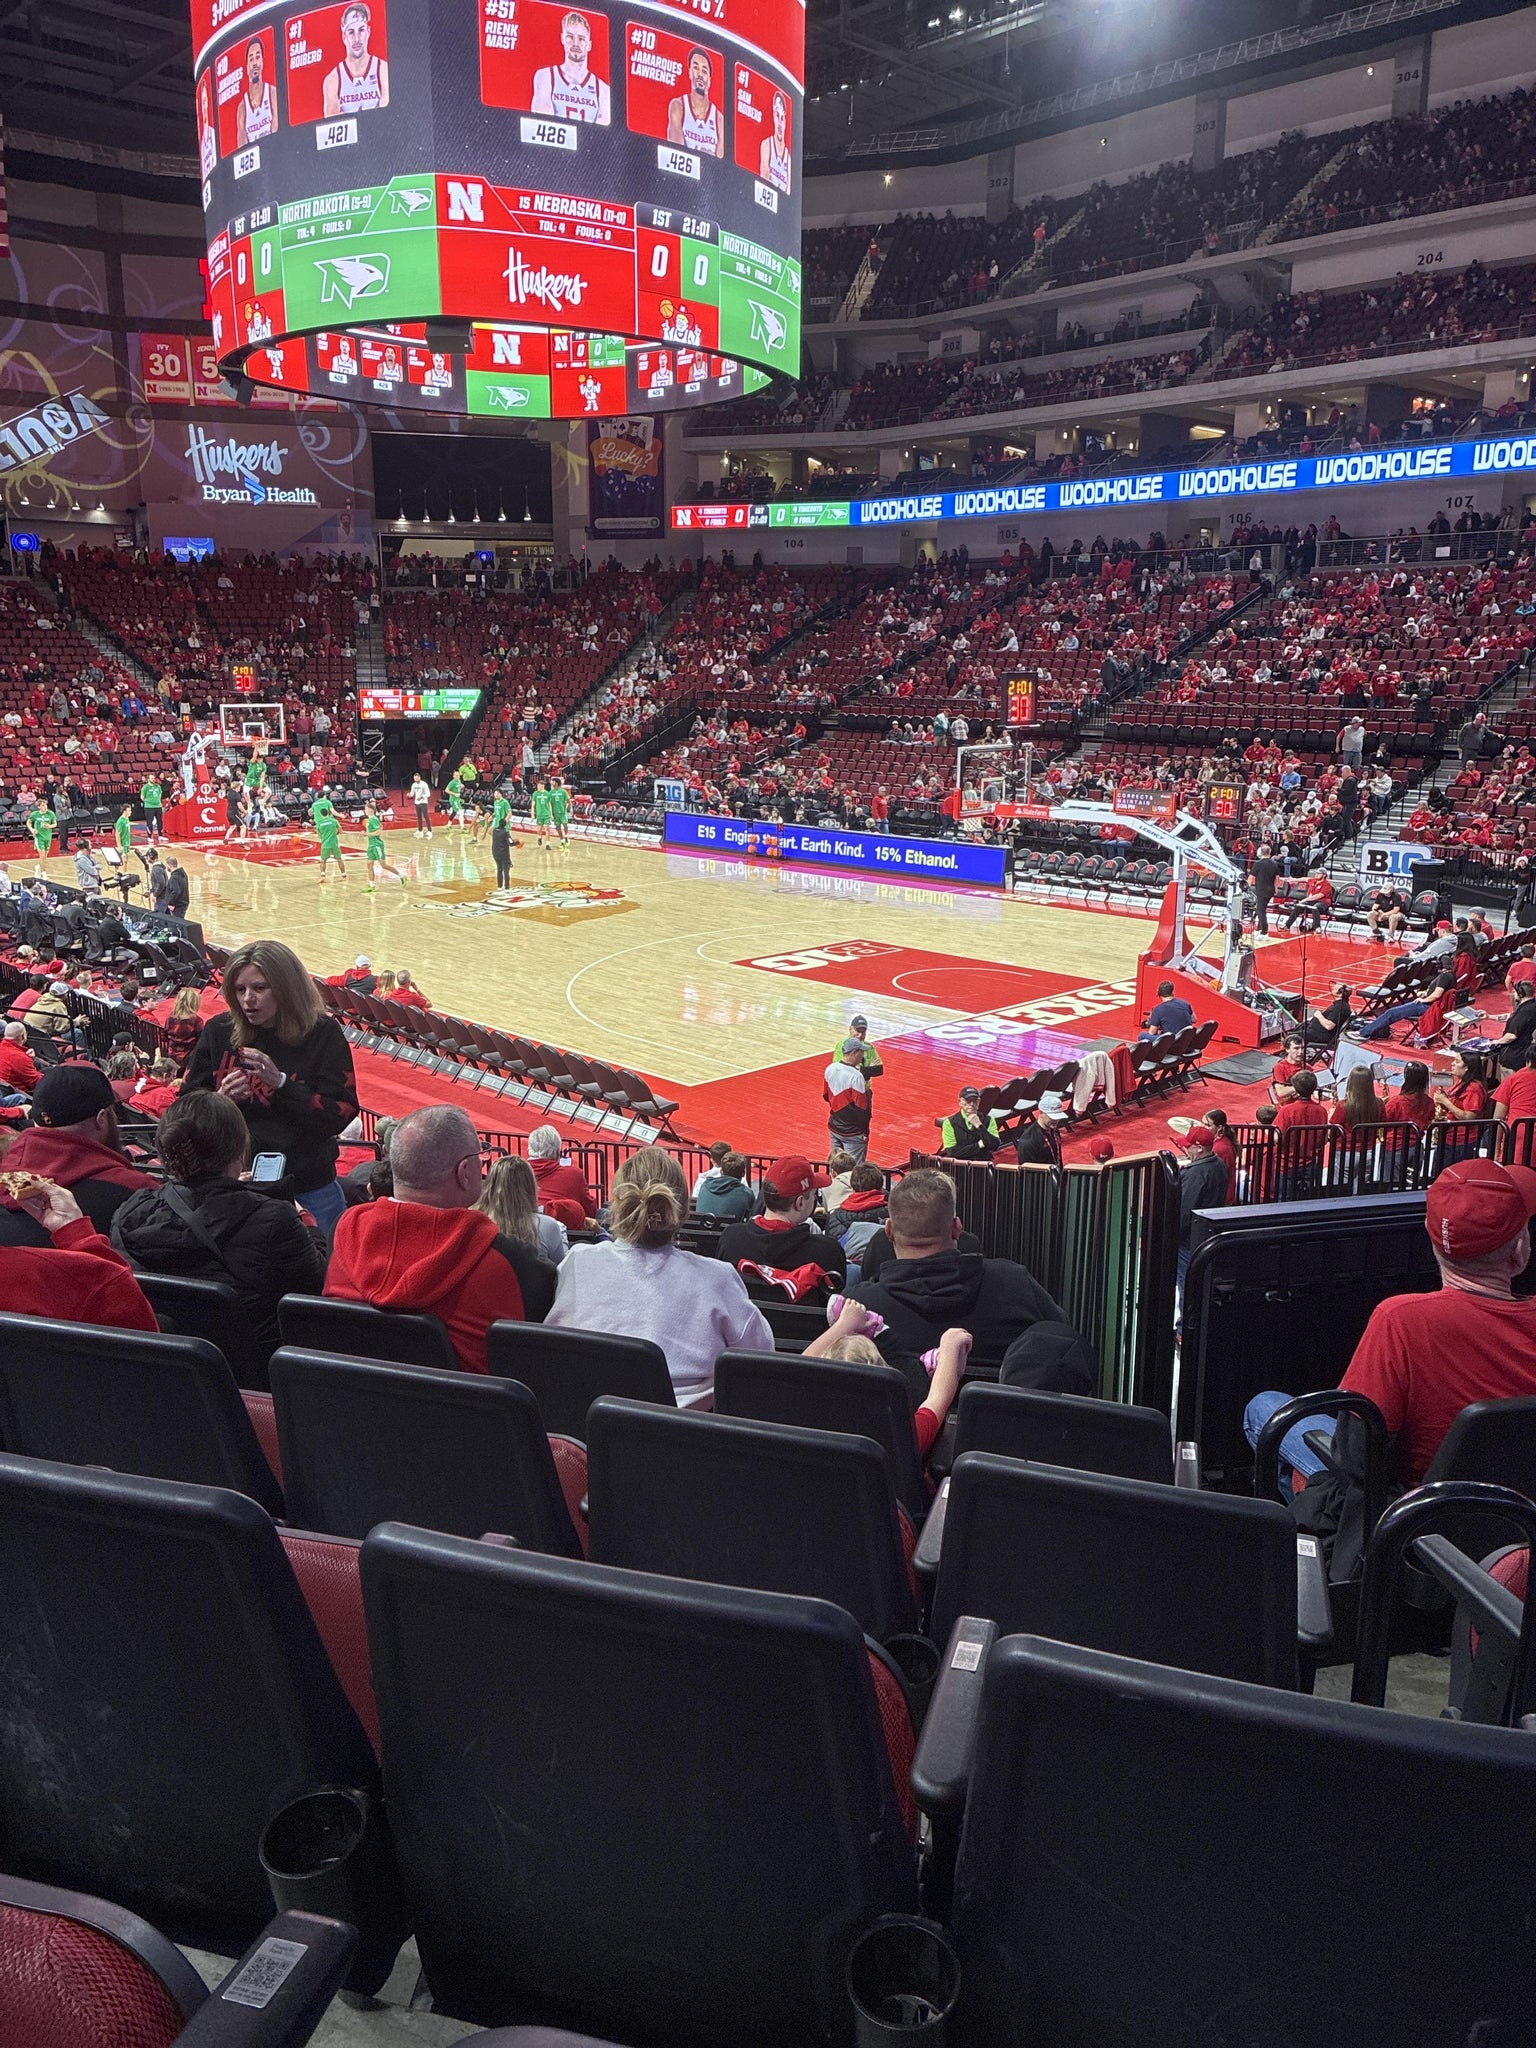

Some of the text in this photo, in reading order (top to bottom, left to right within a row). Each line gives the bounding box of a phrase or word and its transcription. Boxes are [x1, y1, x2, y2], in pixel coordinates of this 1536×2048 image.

[212, 0, 250, 27] 3-POI
[289, 20, 302, 39] #1
[485, 21, 518, 36] RIENK
[290, 40, 306, 57] SAM
[485, 34, 518, 50] MAST
[631, 29, 656, 50] #10
[630, 50, 682, 76] JAMARQUES
[630, 62, 676, 86] LAWRENCE
[738, 70, 749, 88] #1
[1396, 70, 1420, 84] 304
[553, 94, 596, 108] NEBRASKA
[324, 125, 348, 146] .421
[531, 123, 566, 145] .426
[238, 153, 254, 174] .426
[666, 153, 692, 173] .426
[282, 206, 310, 224] NORTH
[312, 194, 350, 216] DAKOTA
[447, 181, 484, 222] N
[534, 194, 601, 220] NEBRASKA
[235, 206, 270, 236] 1ST 21:01
[653, 209, 710, 238] 1ST 21:01
[558, 222, 566, 234] 4
[576, 225, 603, 239] FOULS:
[605, 230, 611, 240] 0
[261, 242, 272, 275] 0
[652, 245, 668, 277] 0
[1417, 252, 1443, 266] 204
[238, 252, 246, 285] 0
[694, 254, 708, 286] 0
[502, 247, 588, 311] Huskers
[492, 333, 521, 364] N
[554, 336, 568, 352] N
[577, 344, 585, 357] 0
[594, 342, 602, 356] 0
[944, 341, 960, 351] 202
[149, 353, 180, 376] 30
[147, 384, 157, 393] N
[197, 386, 208, 396] N
[184, 424, 288, 483] Huskers
[598, 442, 653, 472] Lucky?
[861, 497, 942, 522] WOODHOUSE
[954, 487, 1046, 515] WOODHOUSE
[1060, 476, 1162, 505] WOODHOUSE
[1178, 463, 1297, 496] WOODHOUSE
[1315, 448, 1452, 485] WOODHOUSE
[202, 485, 316, 504] Bryan Health
[1446, 496, 1473, 509] 107
[676, 510, 691, 525] N
[735, 510, 744, 523] 0
[776, 509, 786, 522] 0
[1229, 513, 1252, 524] 106
[1000, 529, 1018, 539] 105
[784, 539, 804, 548] 104
[233, 666, 253, 675] 21:01
[235, 675, 251, 689] 30
[1008, 680, 1033, 695] 21:01
[1011, 696, 1029, 721] 30
[197, 796, 217, 804] fnbo
[1210, 787, 1239, 799] 21:01
[1216, 801, 1232, 816] 30
[193, 824, 226, 833] Channel
[1140, 826, 1164, 840] LEGACY
[698, 825, 715, 839] E15
[724, 828, 760, 845] Engi
[801, 837, 832, 854] Earth
[834, 842, 865, 858] Kind.
[875, 847, 901, 862] 15%
[905, 850, 958, 869] Ethanol.
[1200, 857, 1227, 874] SPORTS
[1365, 875, 1413, 887] NETWOR
